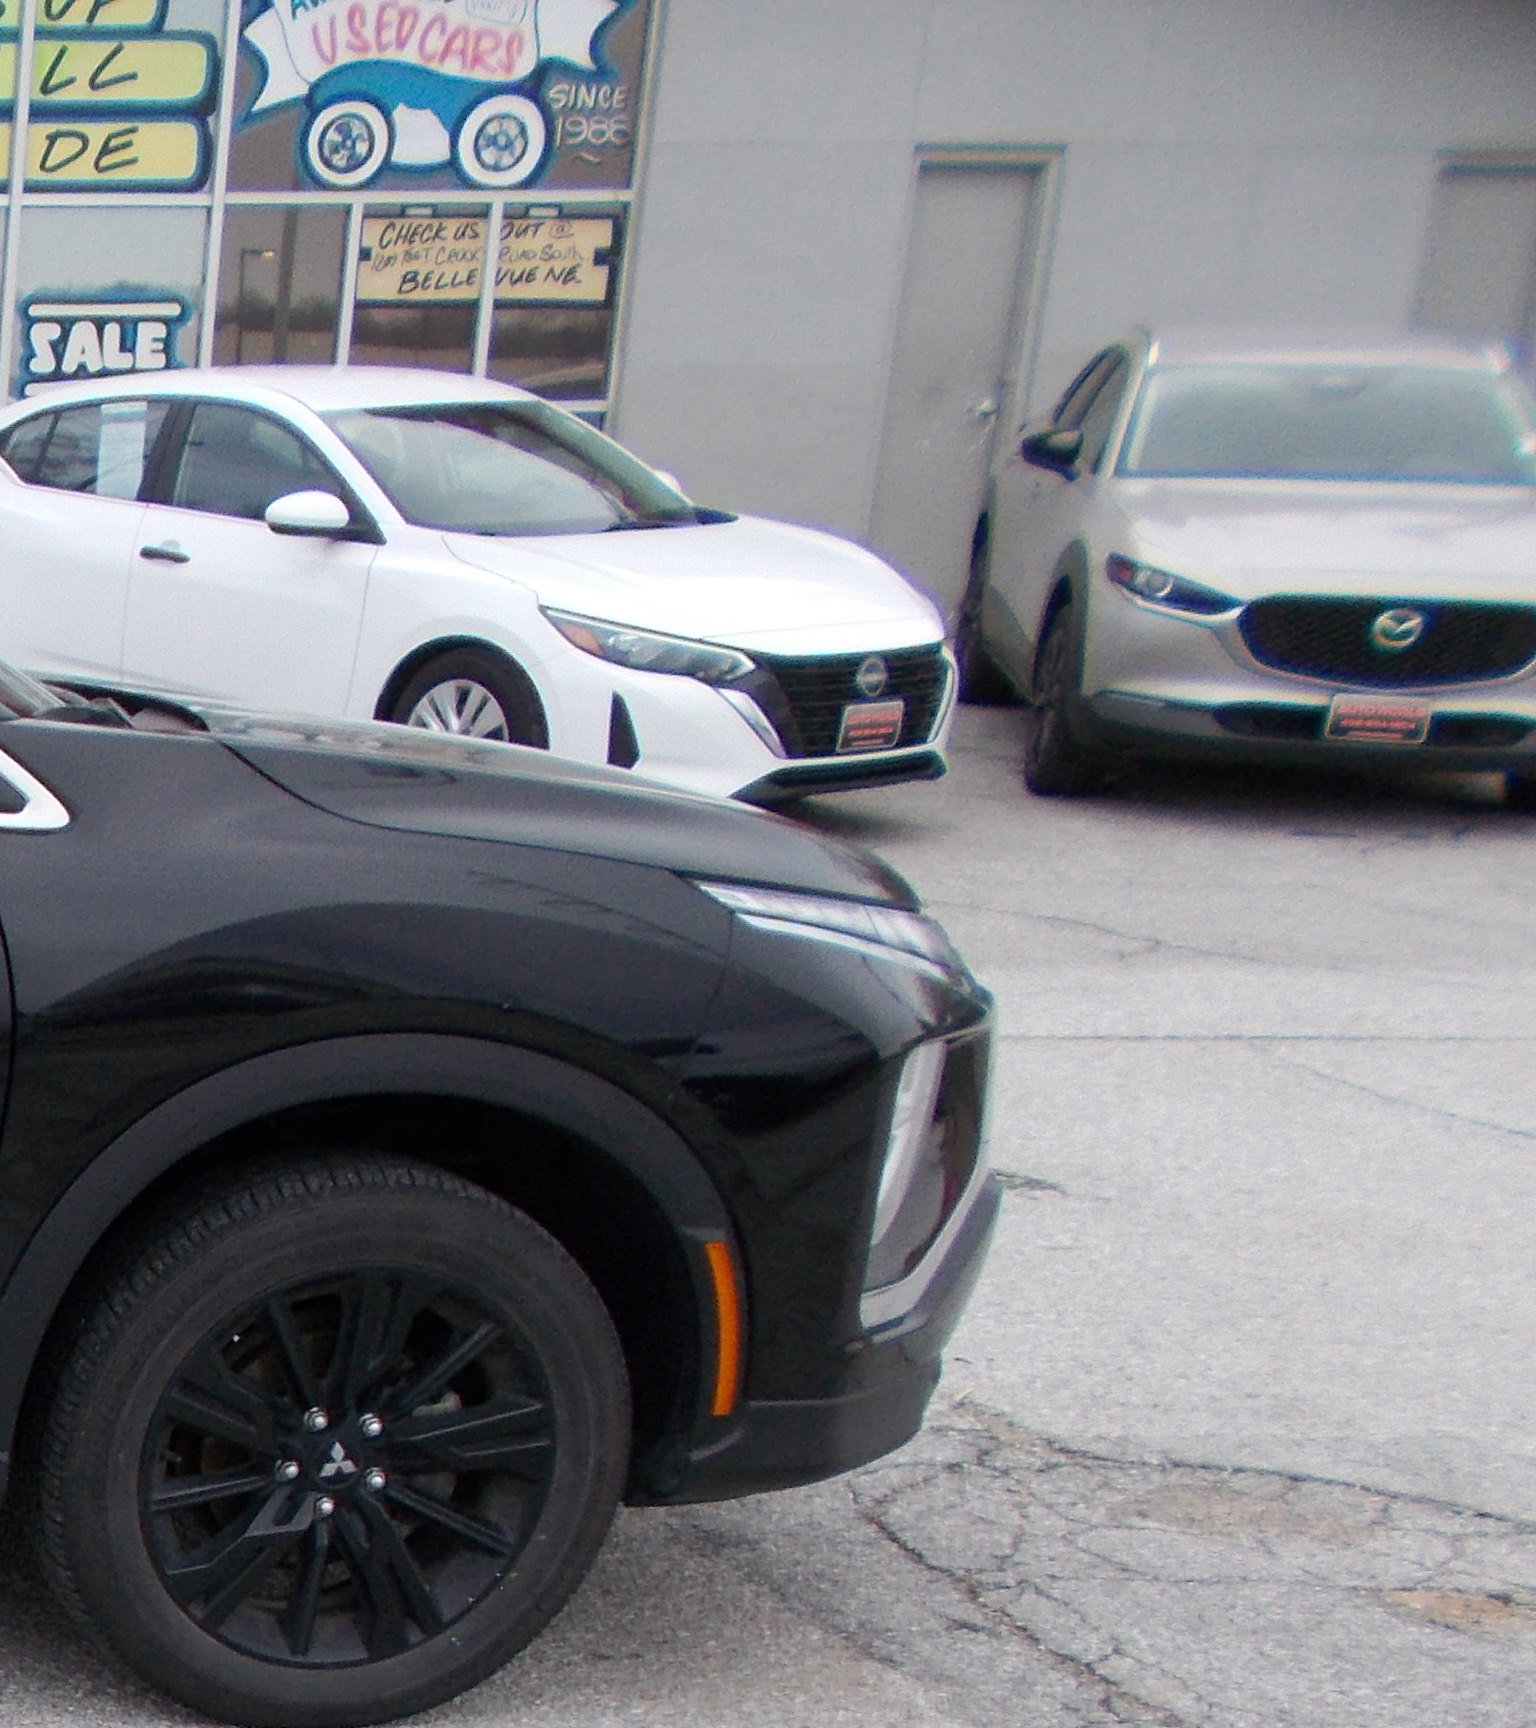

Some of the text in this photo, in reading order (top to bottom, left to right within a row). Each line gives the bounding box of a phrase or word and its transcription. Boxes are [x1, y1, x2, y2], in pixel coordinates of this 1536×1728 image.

[312, 1, 525, 74] USED CARS
[549, 82, 627, 109] SINCE
[378, 220, 448, 249] CHECK
[453, 221, 480, 241] US
[29, 320, 167, 374] SALE
